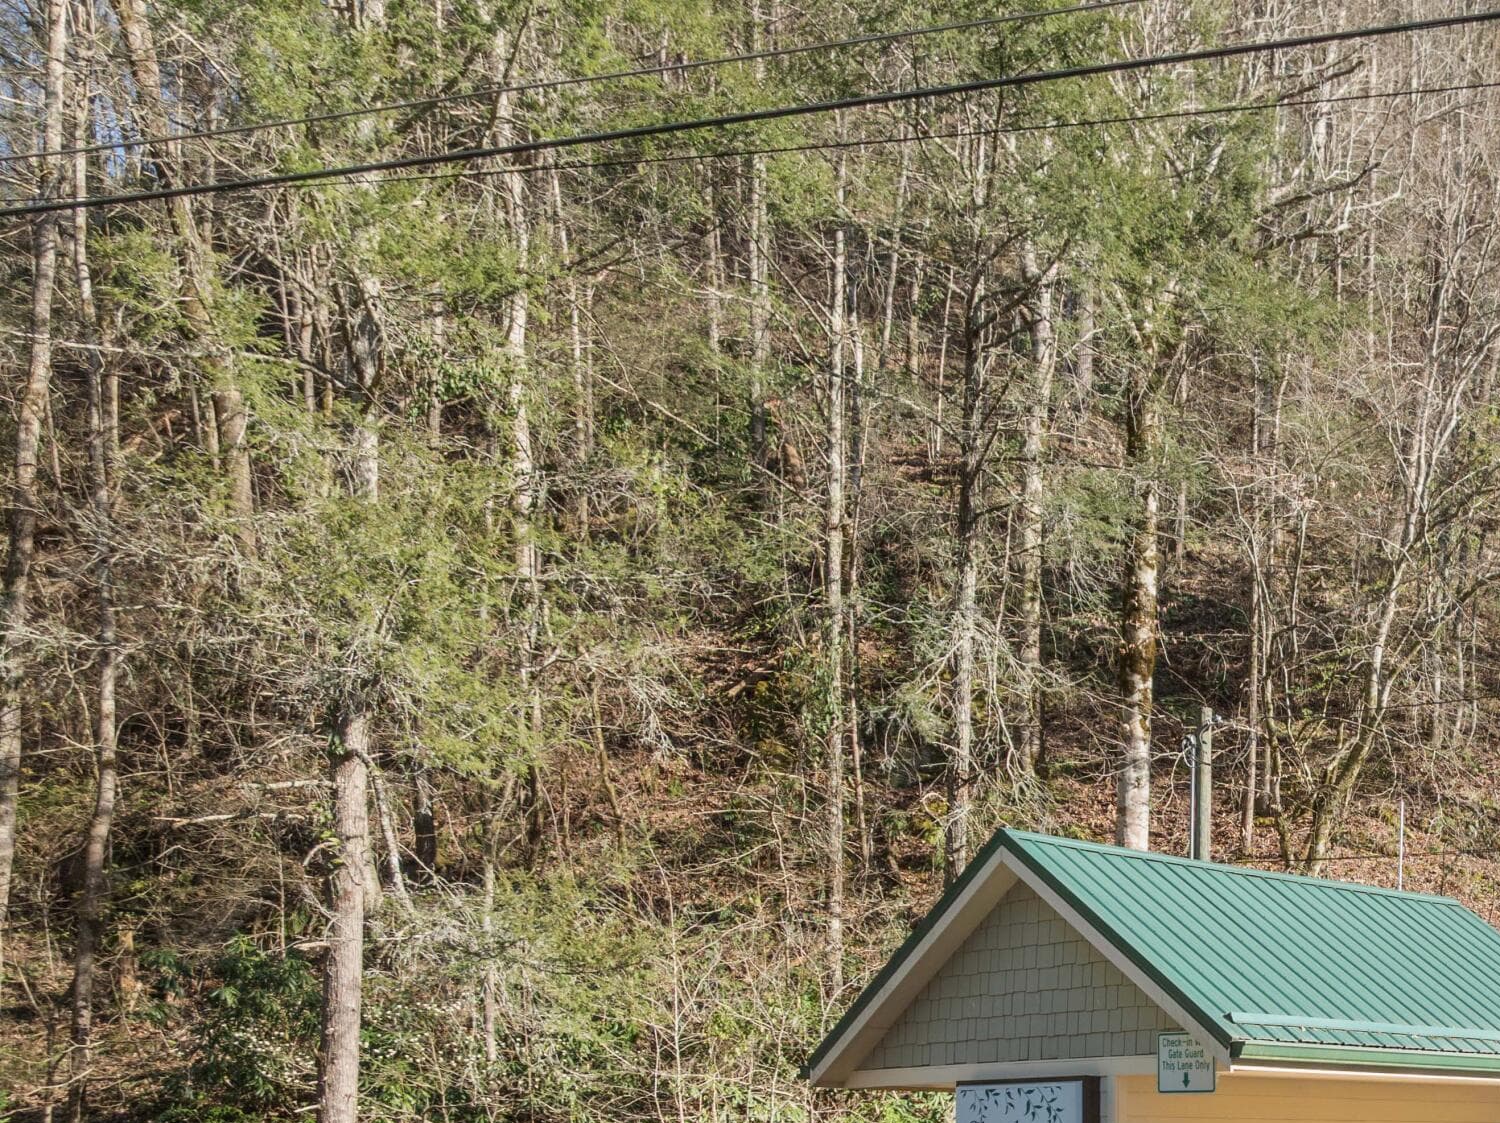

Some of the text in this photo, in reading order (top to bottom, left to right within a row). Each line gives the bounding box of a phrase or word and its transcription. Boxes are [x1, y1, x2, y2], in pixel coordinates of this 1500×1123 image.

[1168, 1048, 1204, 1059] Gate Guard
[1162, 1060, 1210, 1072] This Lane Only
